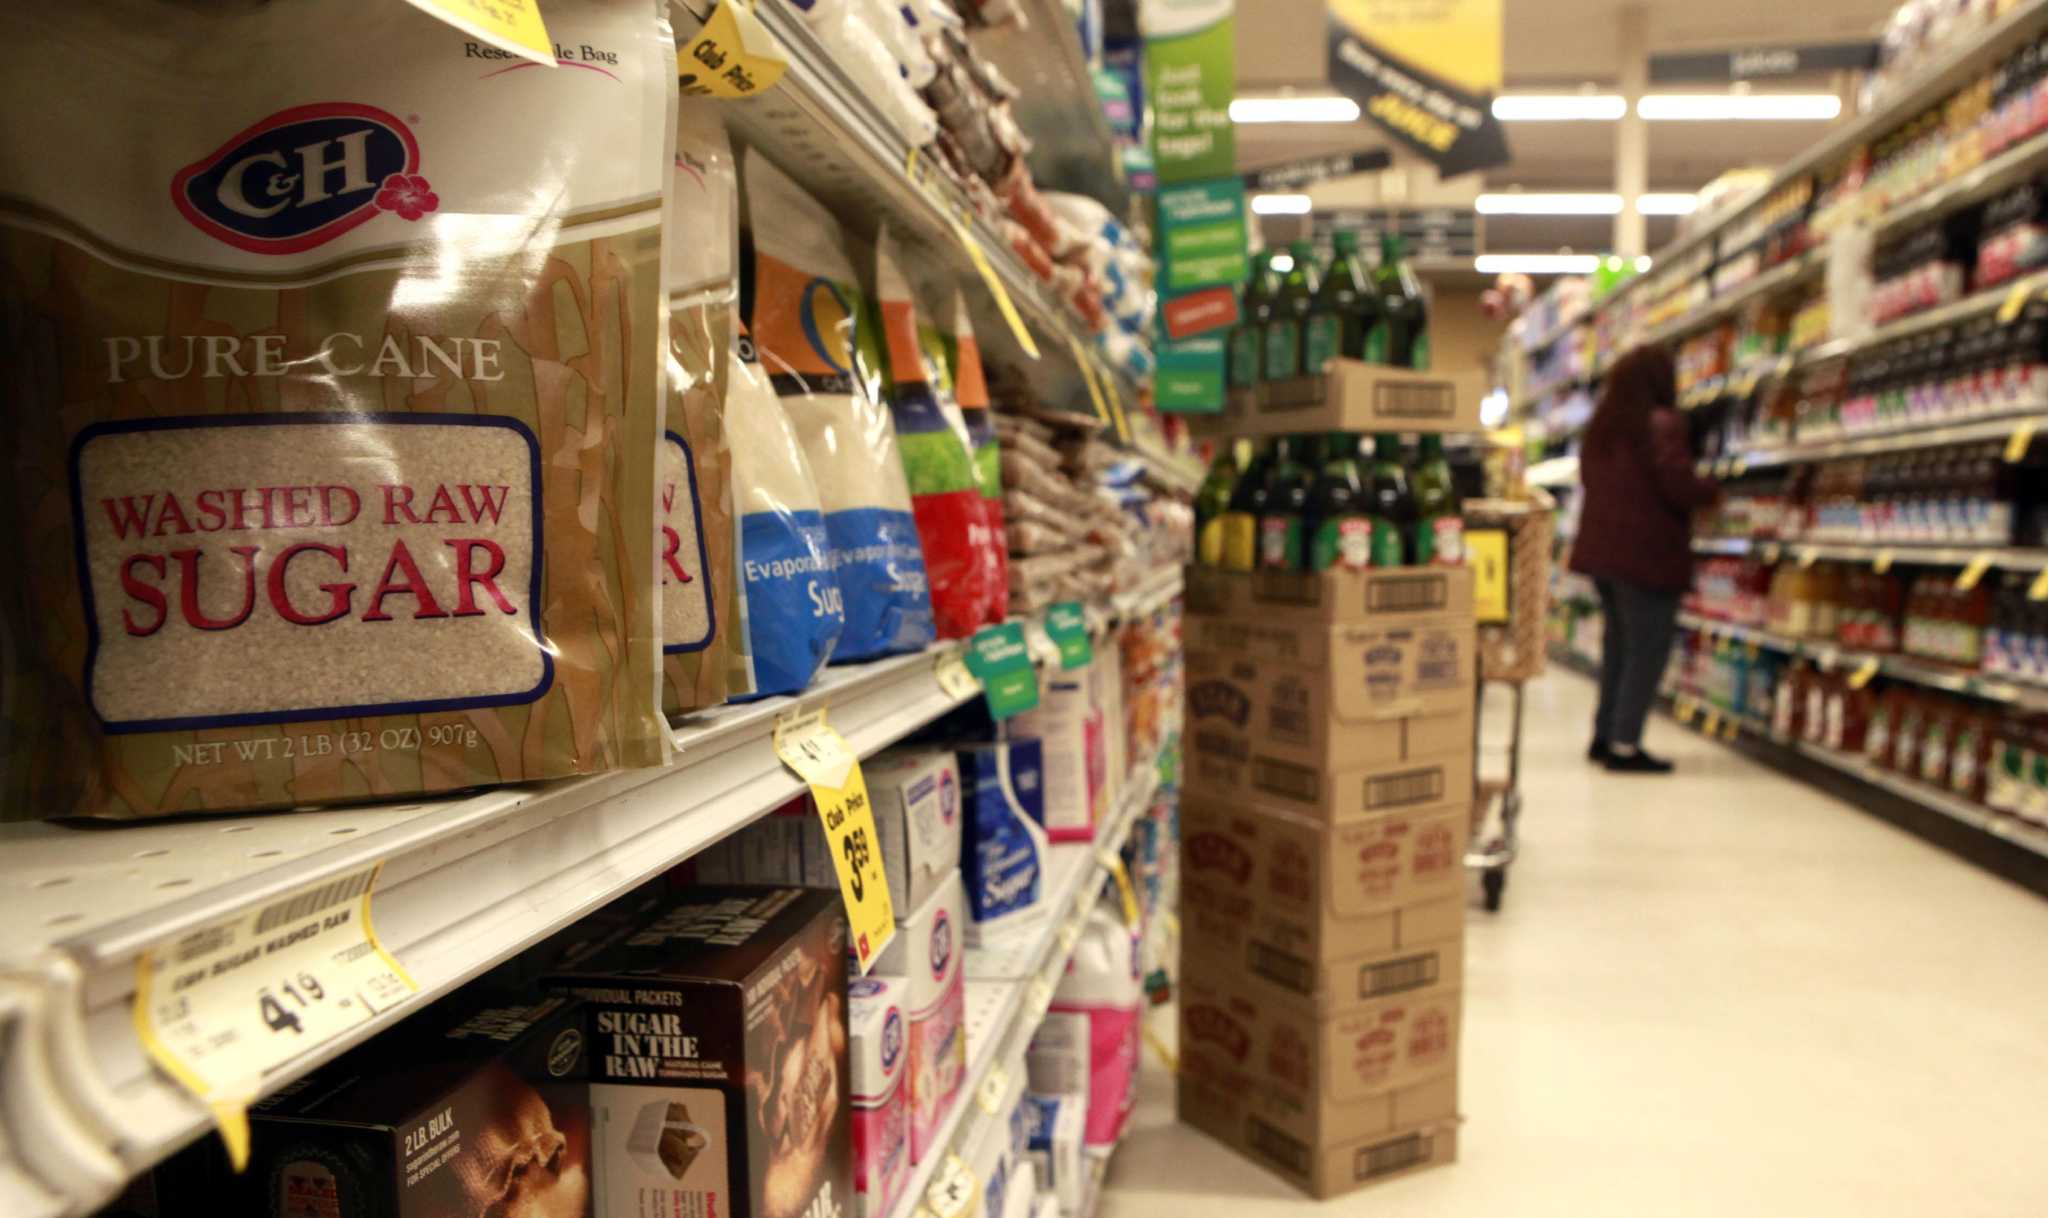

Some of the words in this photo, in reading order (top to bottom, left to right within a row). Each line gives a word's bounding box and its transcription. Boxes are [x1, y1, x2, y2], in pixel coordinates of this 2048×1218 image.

[464, 42, 574, 61] Resele
[580, 45, 618, 65] Bag
[693, 39, 727, 70] Club
[722, 63, 755, 92] Price
[216, 128, 375, 218] C&H
[104, 335, 287, 383] PURE
[320, 331, 505, 382] CANE
[102, 484, 362, 540] WASHED
[379, 484, 511, 526] RAW
[119, 537, 517, 637] SUGAR
[808, 579, 845, 623] Sug
[172, 740, 226, 768] NET
[233, 737, 281, 762] WT
[282, 736, 296, 759] 2
[301, 734, 333, 758] LB
[340, 731, 374, 757] (32
[379, 726, 423, 753] OZ)
[428, 724, 478, 750] 907g
[826, 804, 845, 832] Club
[845, 792, 864, 817] Price
[323, 907, 351, 930] RAW
[597, 1011, 683, 1036] SUGAR
[612, 1033, 641, 1056] IN
[644, 1035, 699, 1058] THE
[604, 1055, 661, 1078] RAW
[404, 1135, 413, 1157] 2
[428, 1106, 454, 1140] BULK
